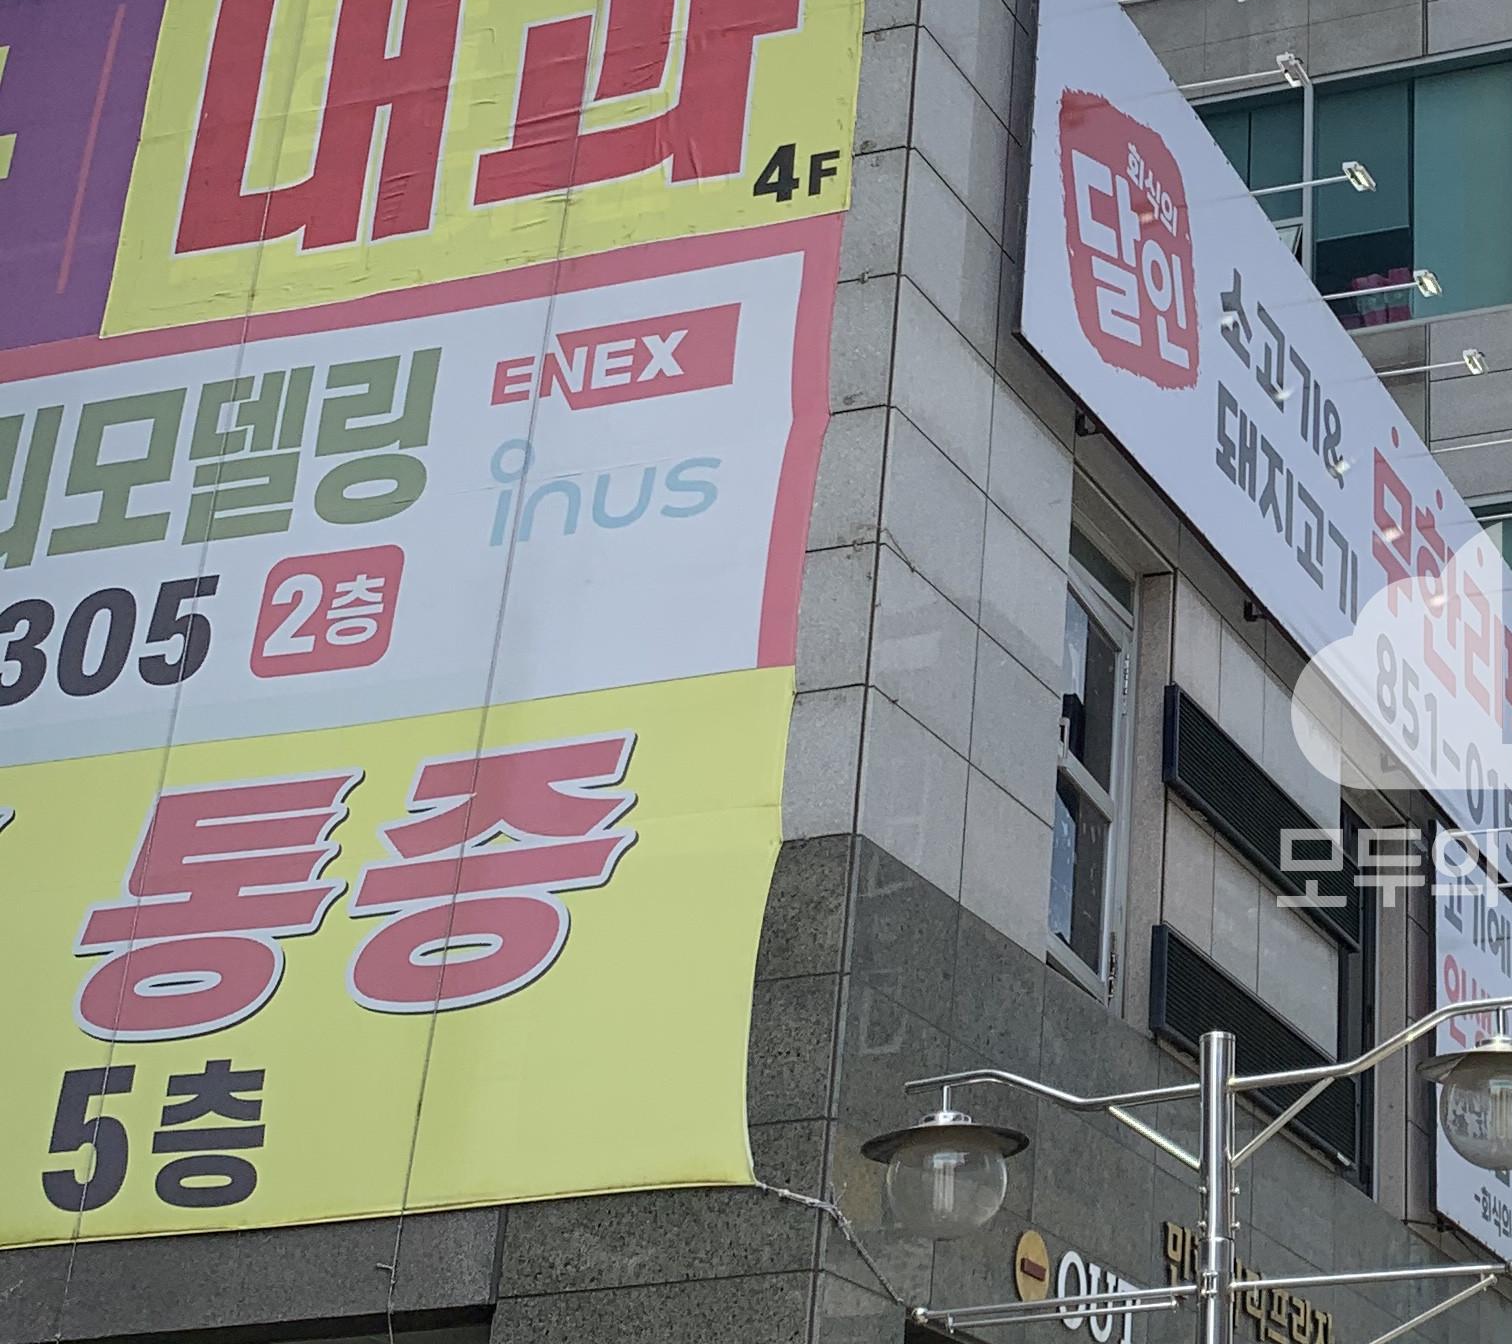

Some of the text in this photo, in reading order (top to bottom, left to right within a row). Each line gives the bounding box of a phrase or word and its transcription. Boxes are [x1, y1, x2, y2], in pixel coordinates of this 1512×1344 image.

[752, 143, 840, 202] 4F
[1126, 141, 1181, 234] 회식의
[1069, 148, 1192, 370] 달인
[501, 329, 688, 405] ENEX
[489, 439, 721, 548] inus
[1215, 379, 1360, 626] 돼지고기
[263, 573, 385, 657] 2층
[74, 731, 637, 1042] 통증
[42, 1059, 266, 1213] 5층
